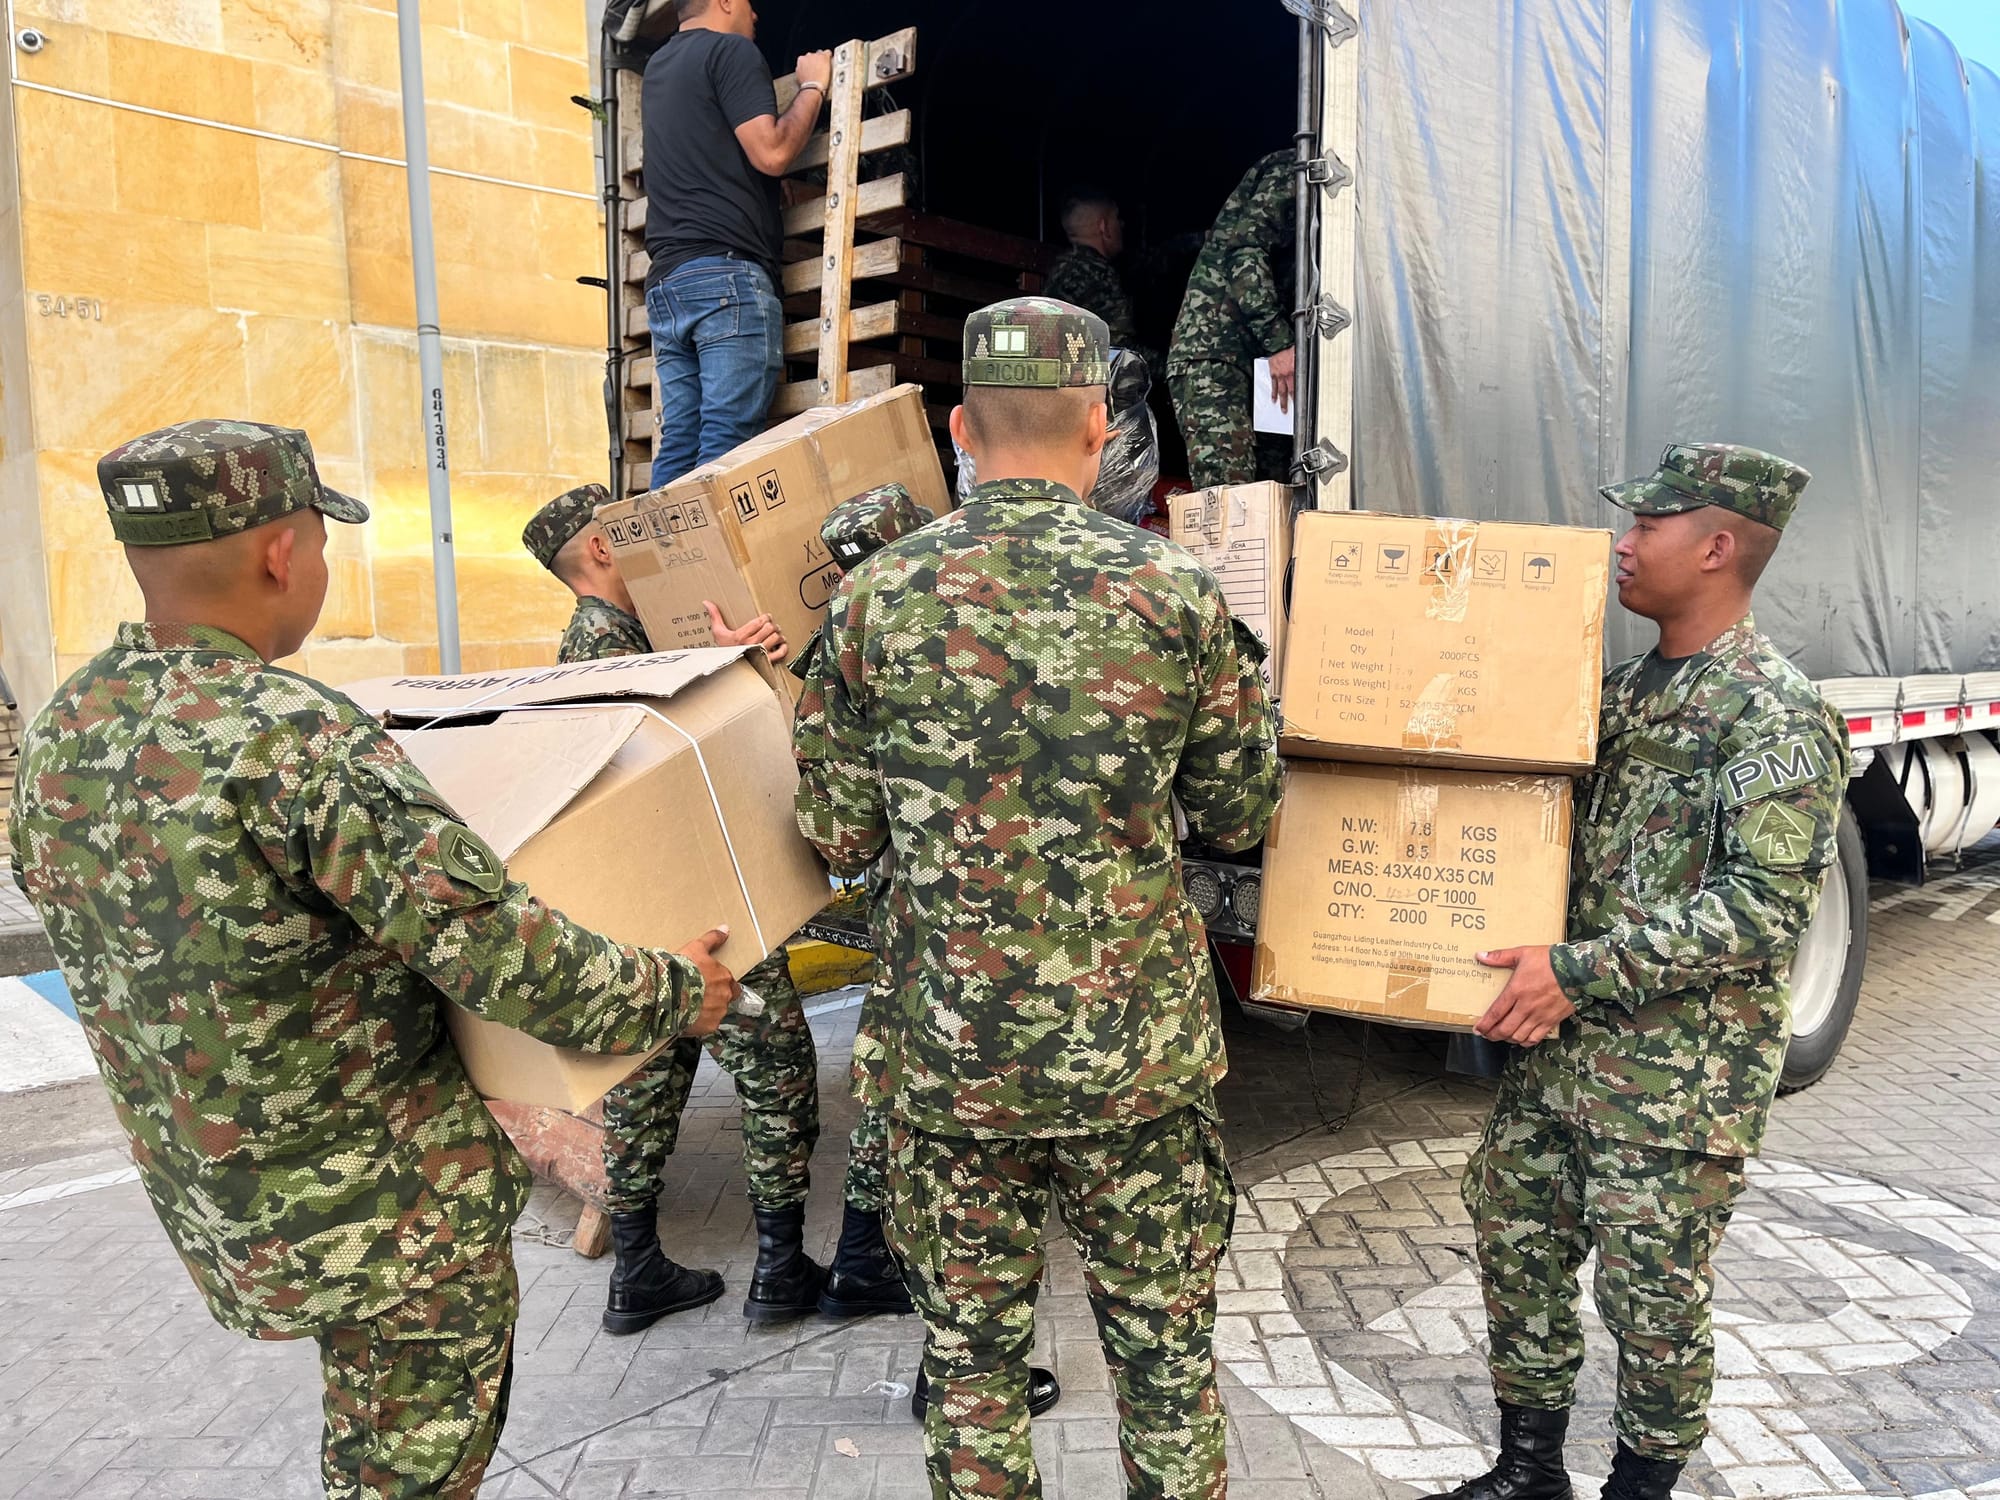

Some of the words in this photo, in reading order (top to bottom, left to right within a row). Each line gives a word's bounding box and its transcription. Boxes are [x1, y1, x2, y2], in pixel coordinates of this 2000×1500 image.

[1345, 626, 1374, 637] Model
[1350, 643, 1367, 655] Qty
[1328, 659, 1345, 669] Net
[1459, 669, 1479, 680] KGS
[1332, 693, 1351, 704] CTN
[1356, 694, 1376, 705] Size
[1457, 686, 1477, 696] KGS
[1726, 742, 1816, 801] PM
[1341, 817, 1378, 835] N.W:
[1461, 825, 1498, 843] KGS
[1342, 838, 1380, 856] G.W:
[1460, 847, 1497, 864] KGS
[1774, 842, 1786, 856] 5
[1328, 859, 1379, 877] MEAS:
[1333, 881, 1377, 899] C/NO.
[1417, 887, 1440, 903] OF
[1443, 889, 1477, 906] 1000
[1327, 902, 1365, 921] QTY:
[1389, 907, 1428, 925] 2000
[1450, 913, 1486, 931] PCS
[1312, 931, 1352, 942] Guangzhou
[1376, 937, 1402, 946] Leather
[1403, 940, 1431, 950] Industry
